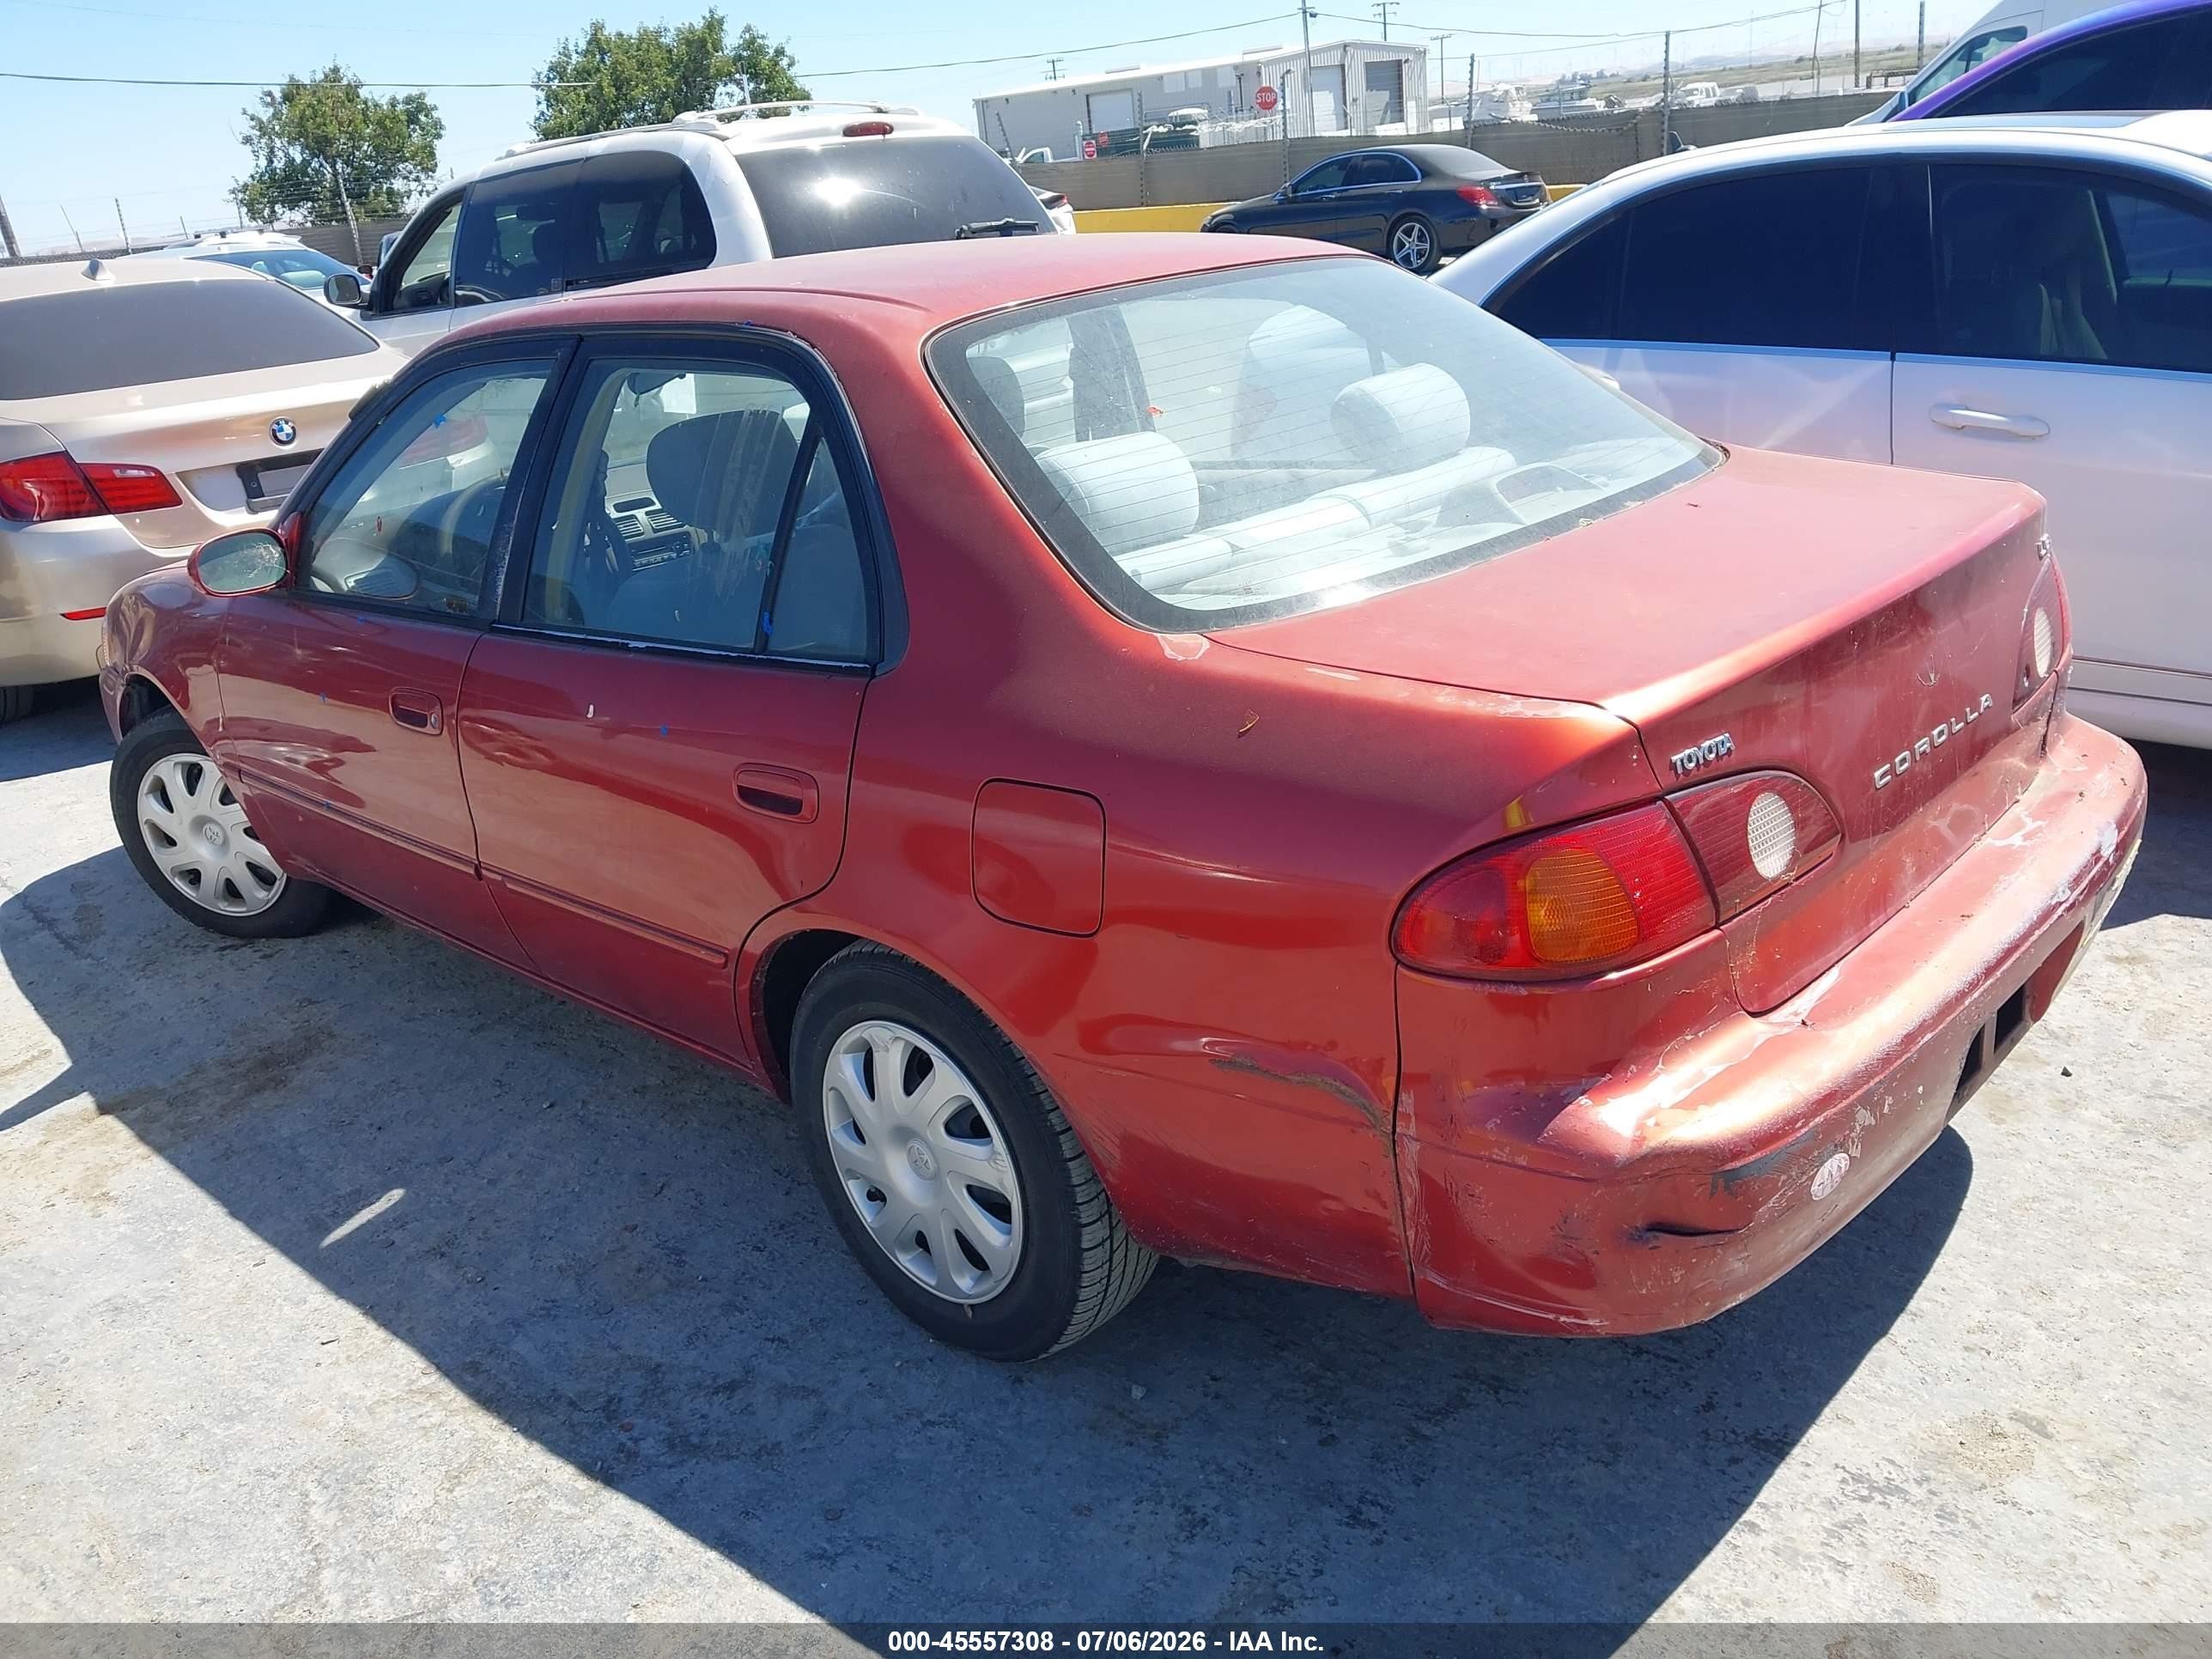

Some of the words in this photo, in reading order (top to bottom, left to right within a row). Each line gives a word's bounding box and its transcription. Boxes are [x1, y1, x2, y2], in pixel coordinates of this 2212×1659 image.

[1256, 92, 1276, 103] STOP
[1670, 732, 1735, 775] TOYOTA
[1874, 694, 1993, 789] COROLLA
